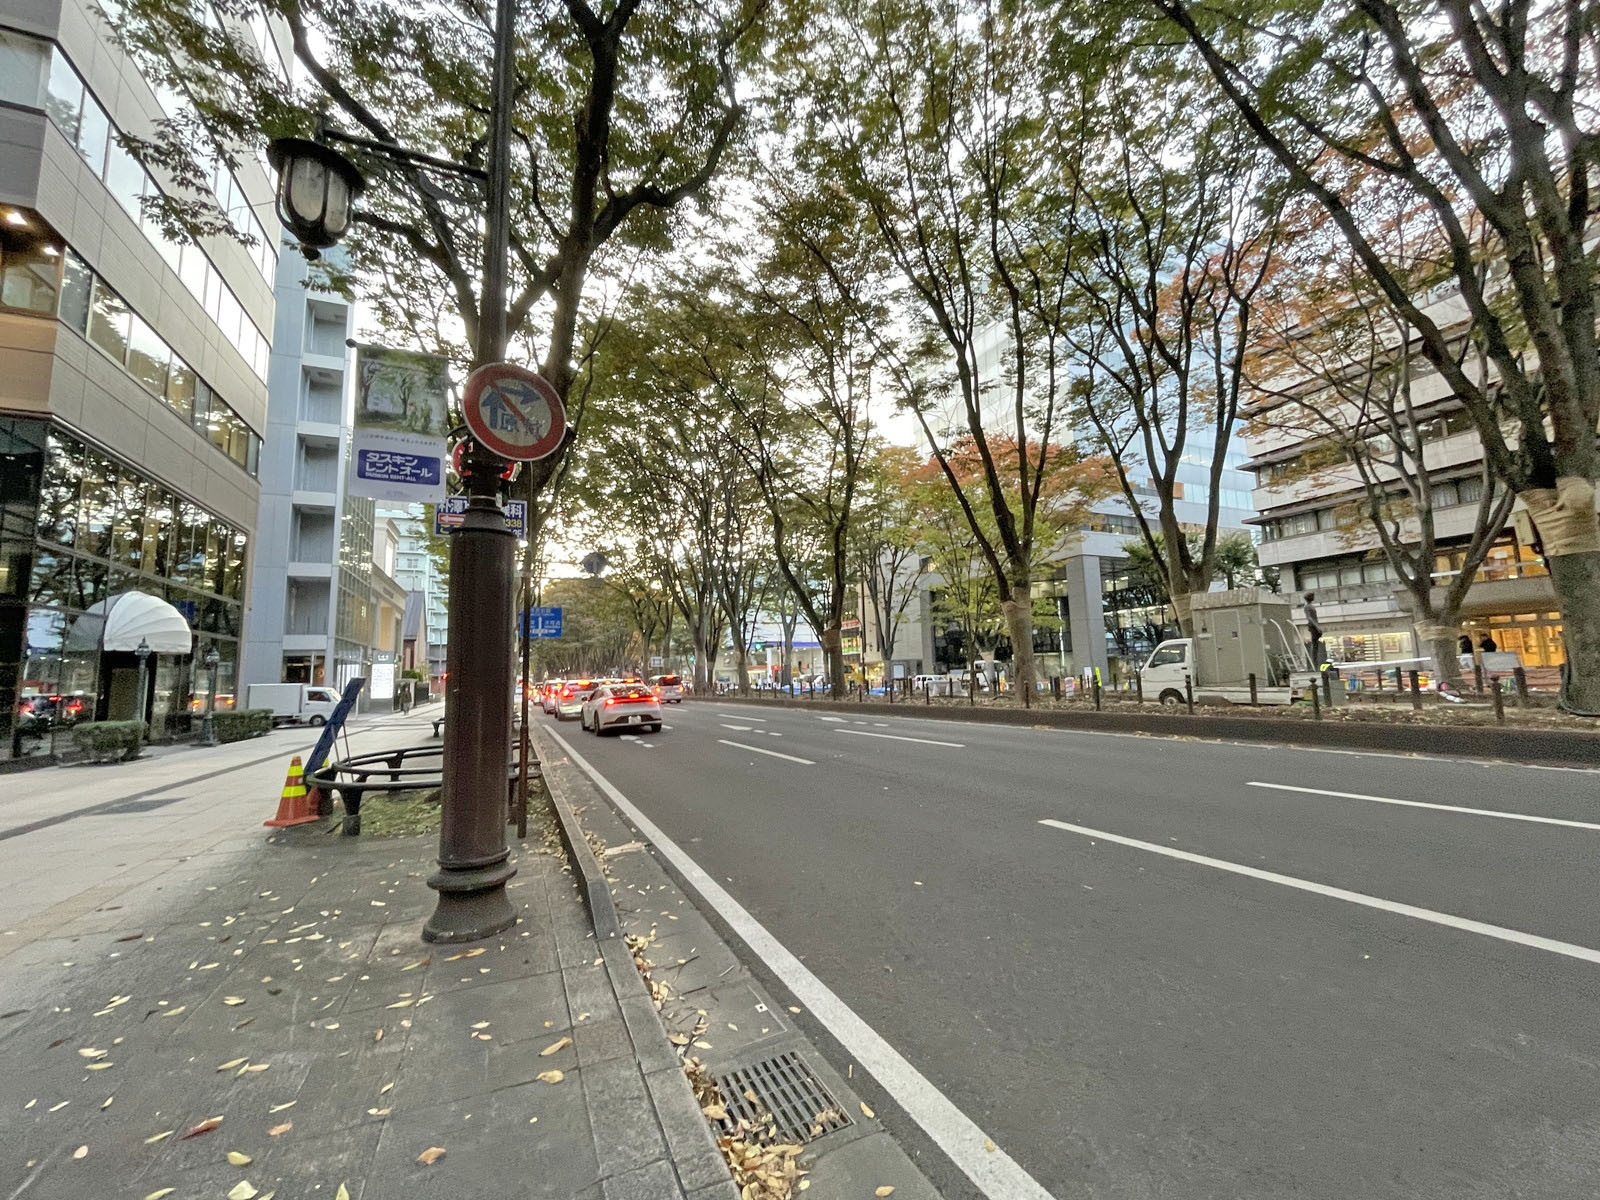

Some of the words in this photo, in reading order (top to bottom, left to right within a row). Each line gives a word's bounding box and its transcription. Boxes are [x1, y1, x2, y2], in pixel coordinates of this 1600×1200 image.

[365, 462, 433, 478] レントオール
